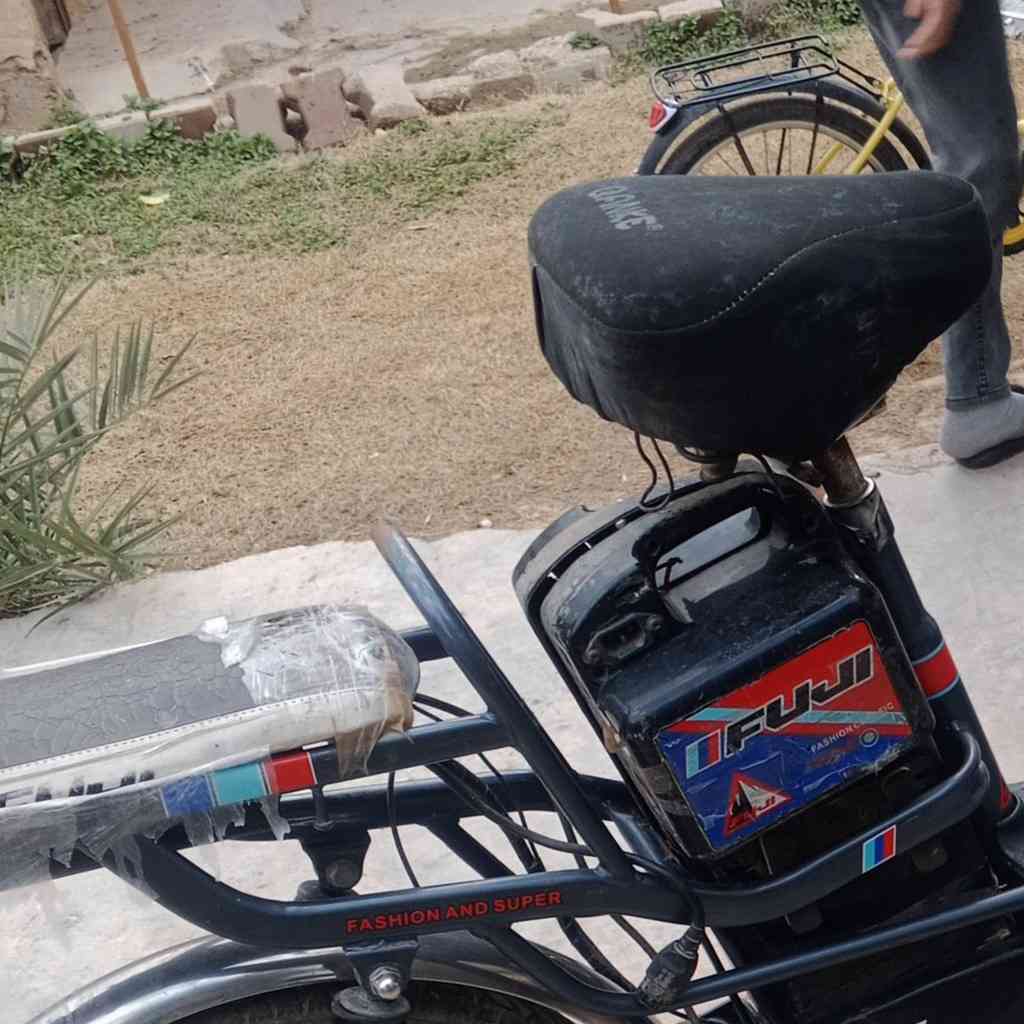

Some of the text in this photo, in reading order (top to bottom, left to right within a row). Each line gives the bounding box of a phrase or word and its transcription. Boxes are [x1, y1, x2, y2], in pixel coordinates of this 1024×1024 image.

[724, 645, 873, 757] FUJI
[346, 891, 561, 933] FASHION AND SUPER
